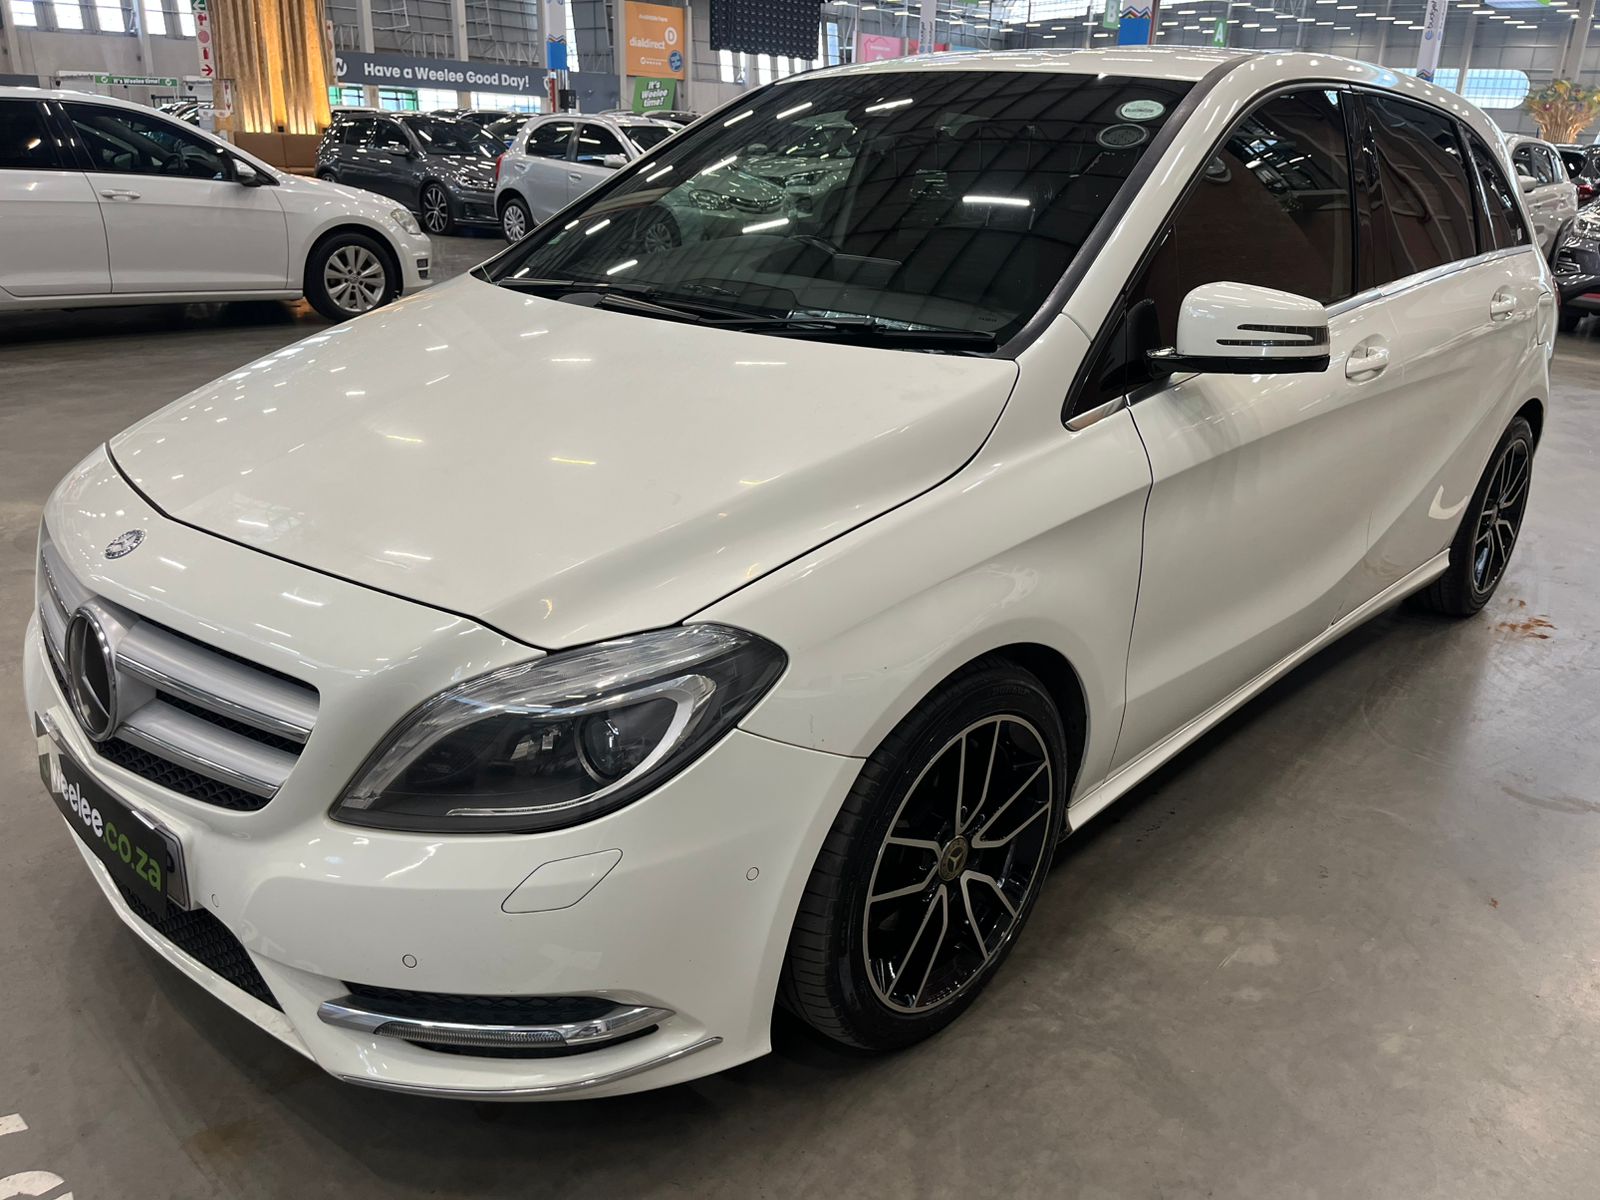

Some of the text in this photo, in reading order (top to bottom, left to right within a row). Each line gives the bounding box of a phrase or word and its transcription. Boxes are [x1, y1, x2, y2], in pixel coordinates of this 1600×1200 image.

[1214, 22, 1224, 43] A
[363, 62, 530, 91] Have a Weelee Good Day!
